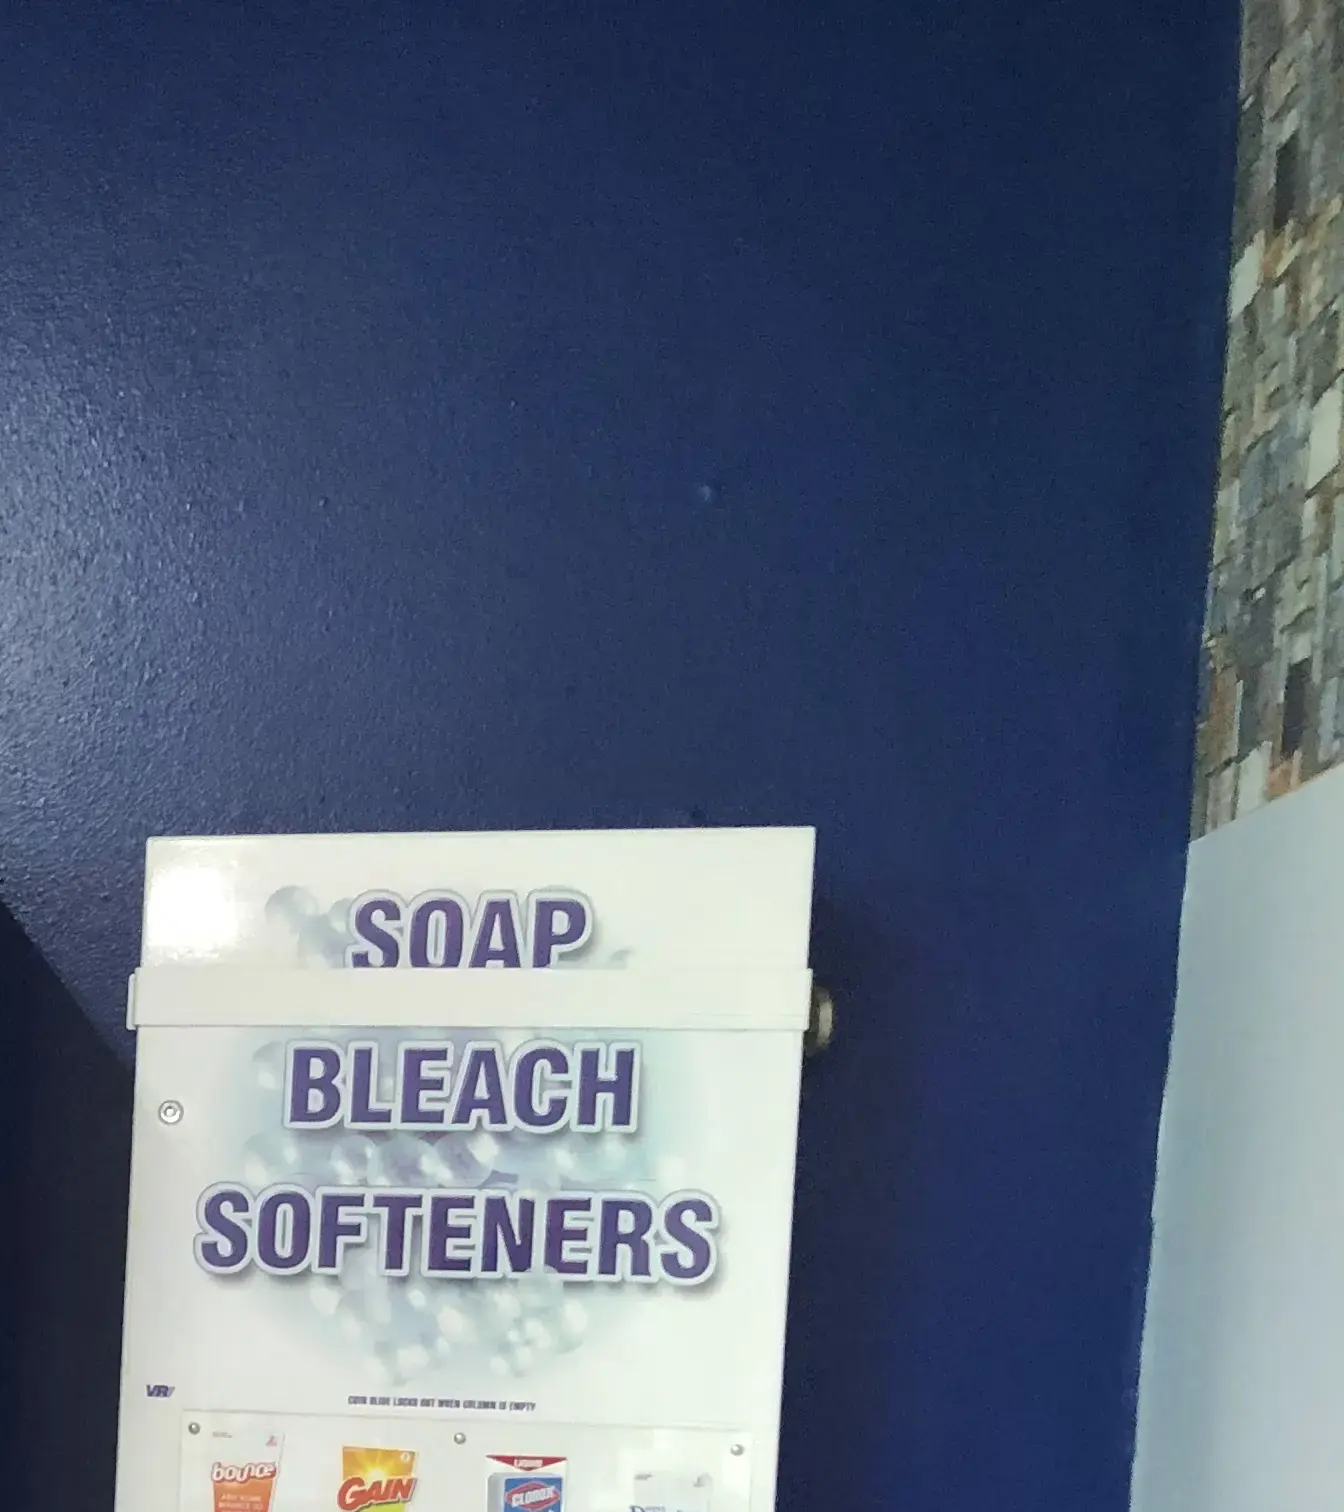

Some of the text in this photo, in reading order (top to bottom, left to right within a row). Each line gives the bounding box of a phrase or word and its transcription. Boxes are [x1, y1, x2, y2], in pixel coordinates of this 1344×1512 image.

[348, 893, 593, 968] SOAP
[286, 1041, 640, 1131] BLEACH
[197, 1187, 717, 1282] SOFTENERS
[510, 1401, 536, 1411] EMPTY
[212, 1462, 277, 1483] bounce
